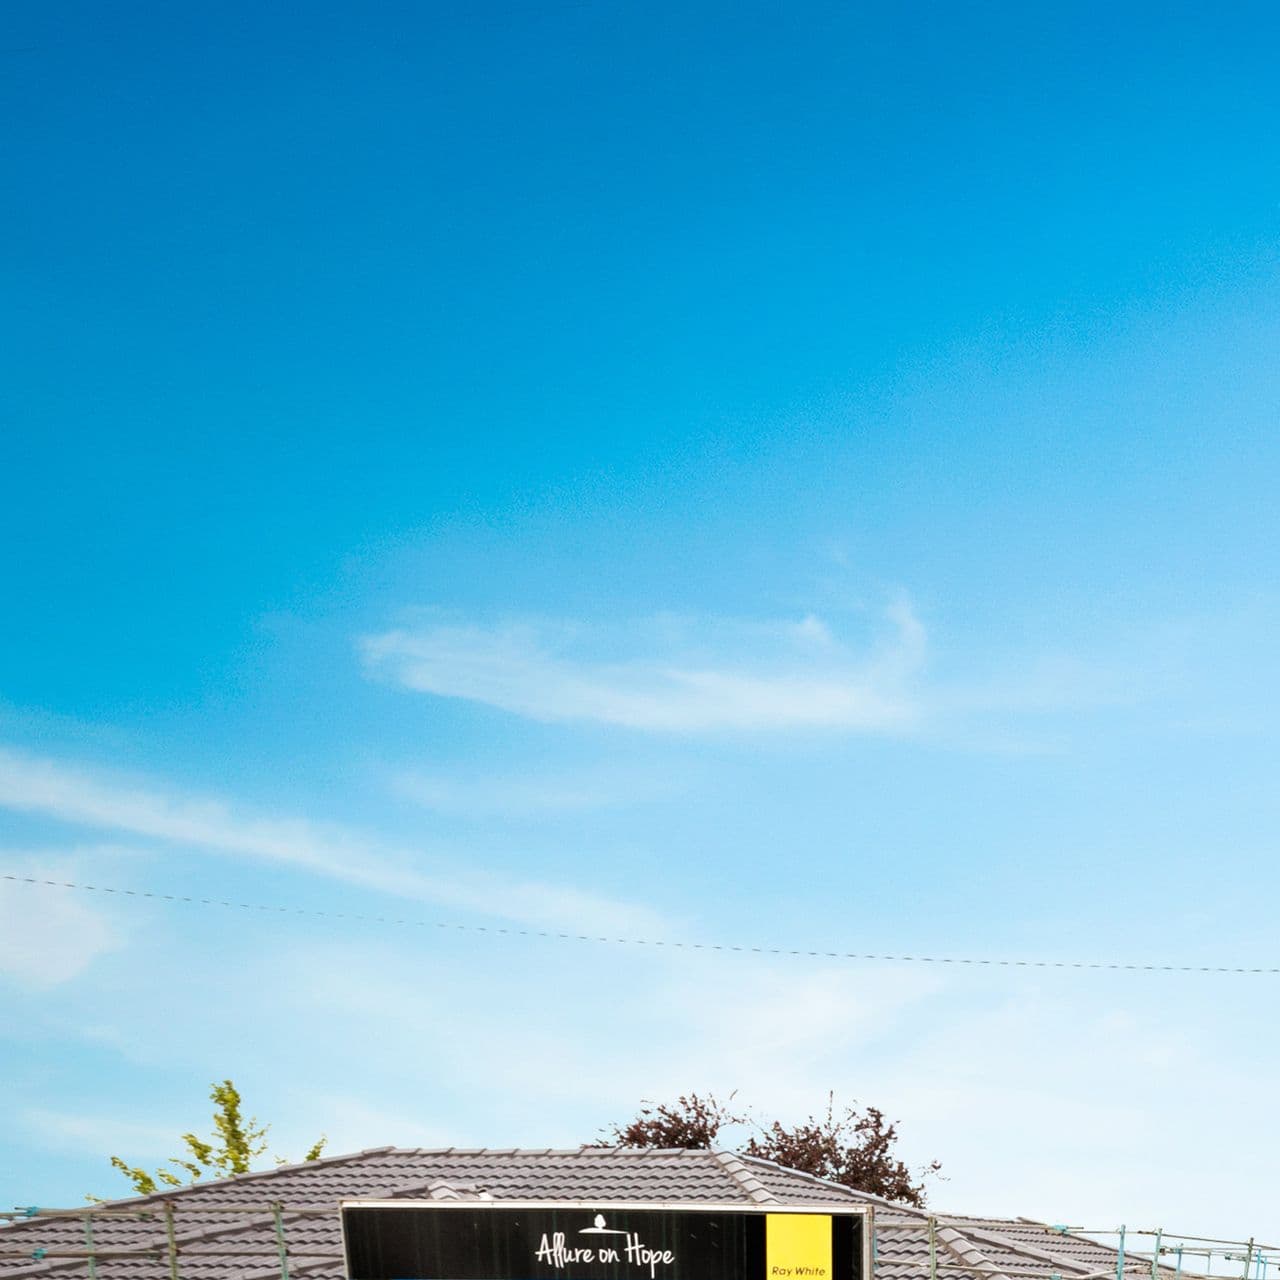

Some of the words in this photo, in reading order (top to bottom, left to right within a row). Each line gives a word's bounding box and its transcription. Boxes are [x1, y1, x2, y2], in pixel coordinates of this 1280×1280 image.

[535, 1231, 595, 1268] Allure
[599, 1247, 621, 1264] on
[624, 1232, 675, 1280] Hope
[771, 1266, 792, 1277] Ray
[795, 1267, 826, 1276] White
